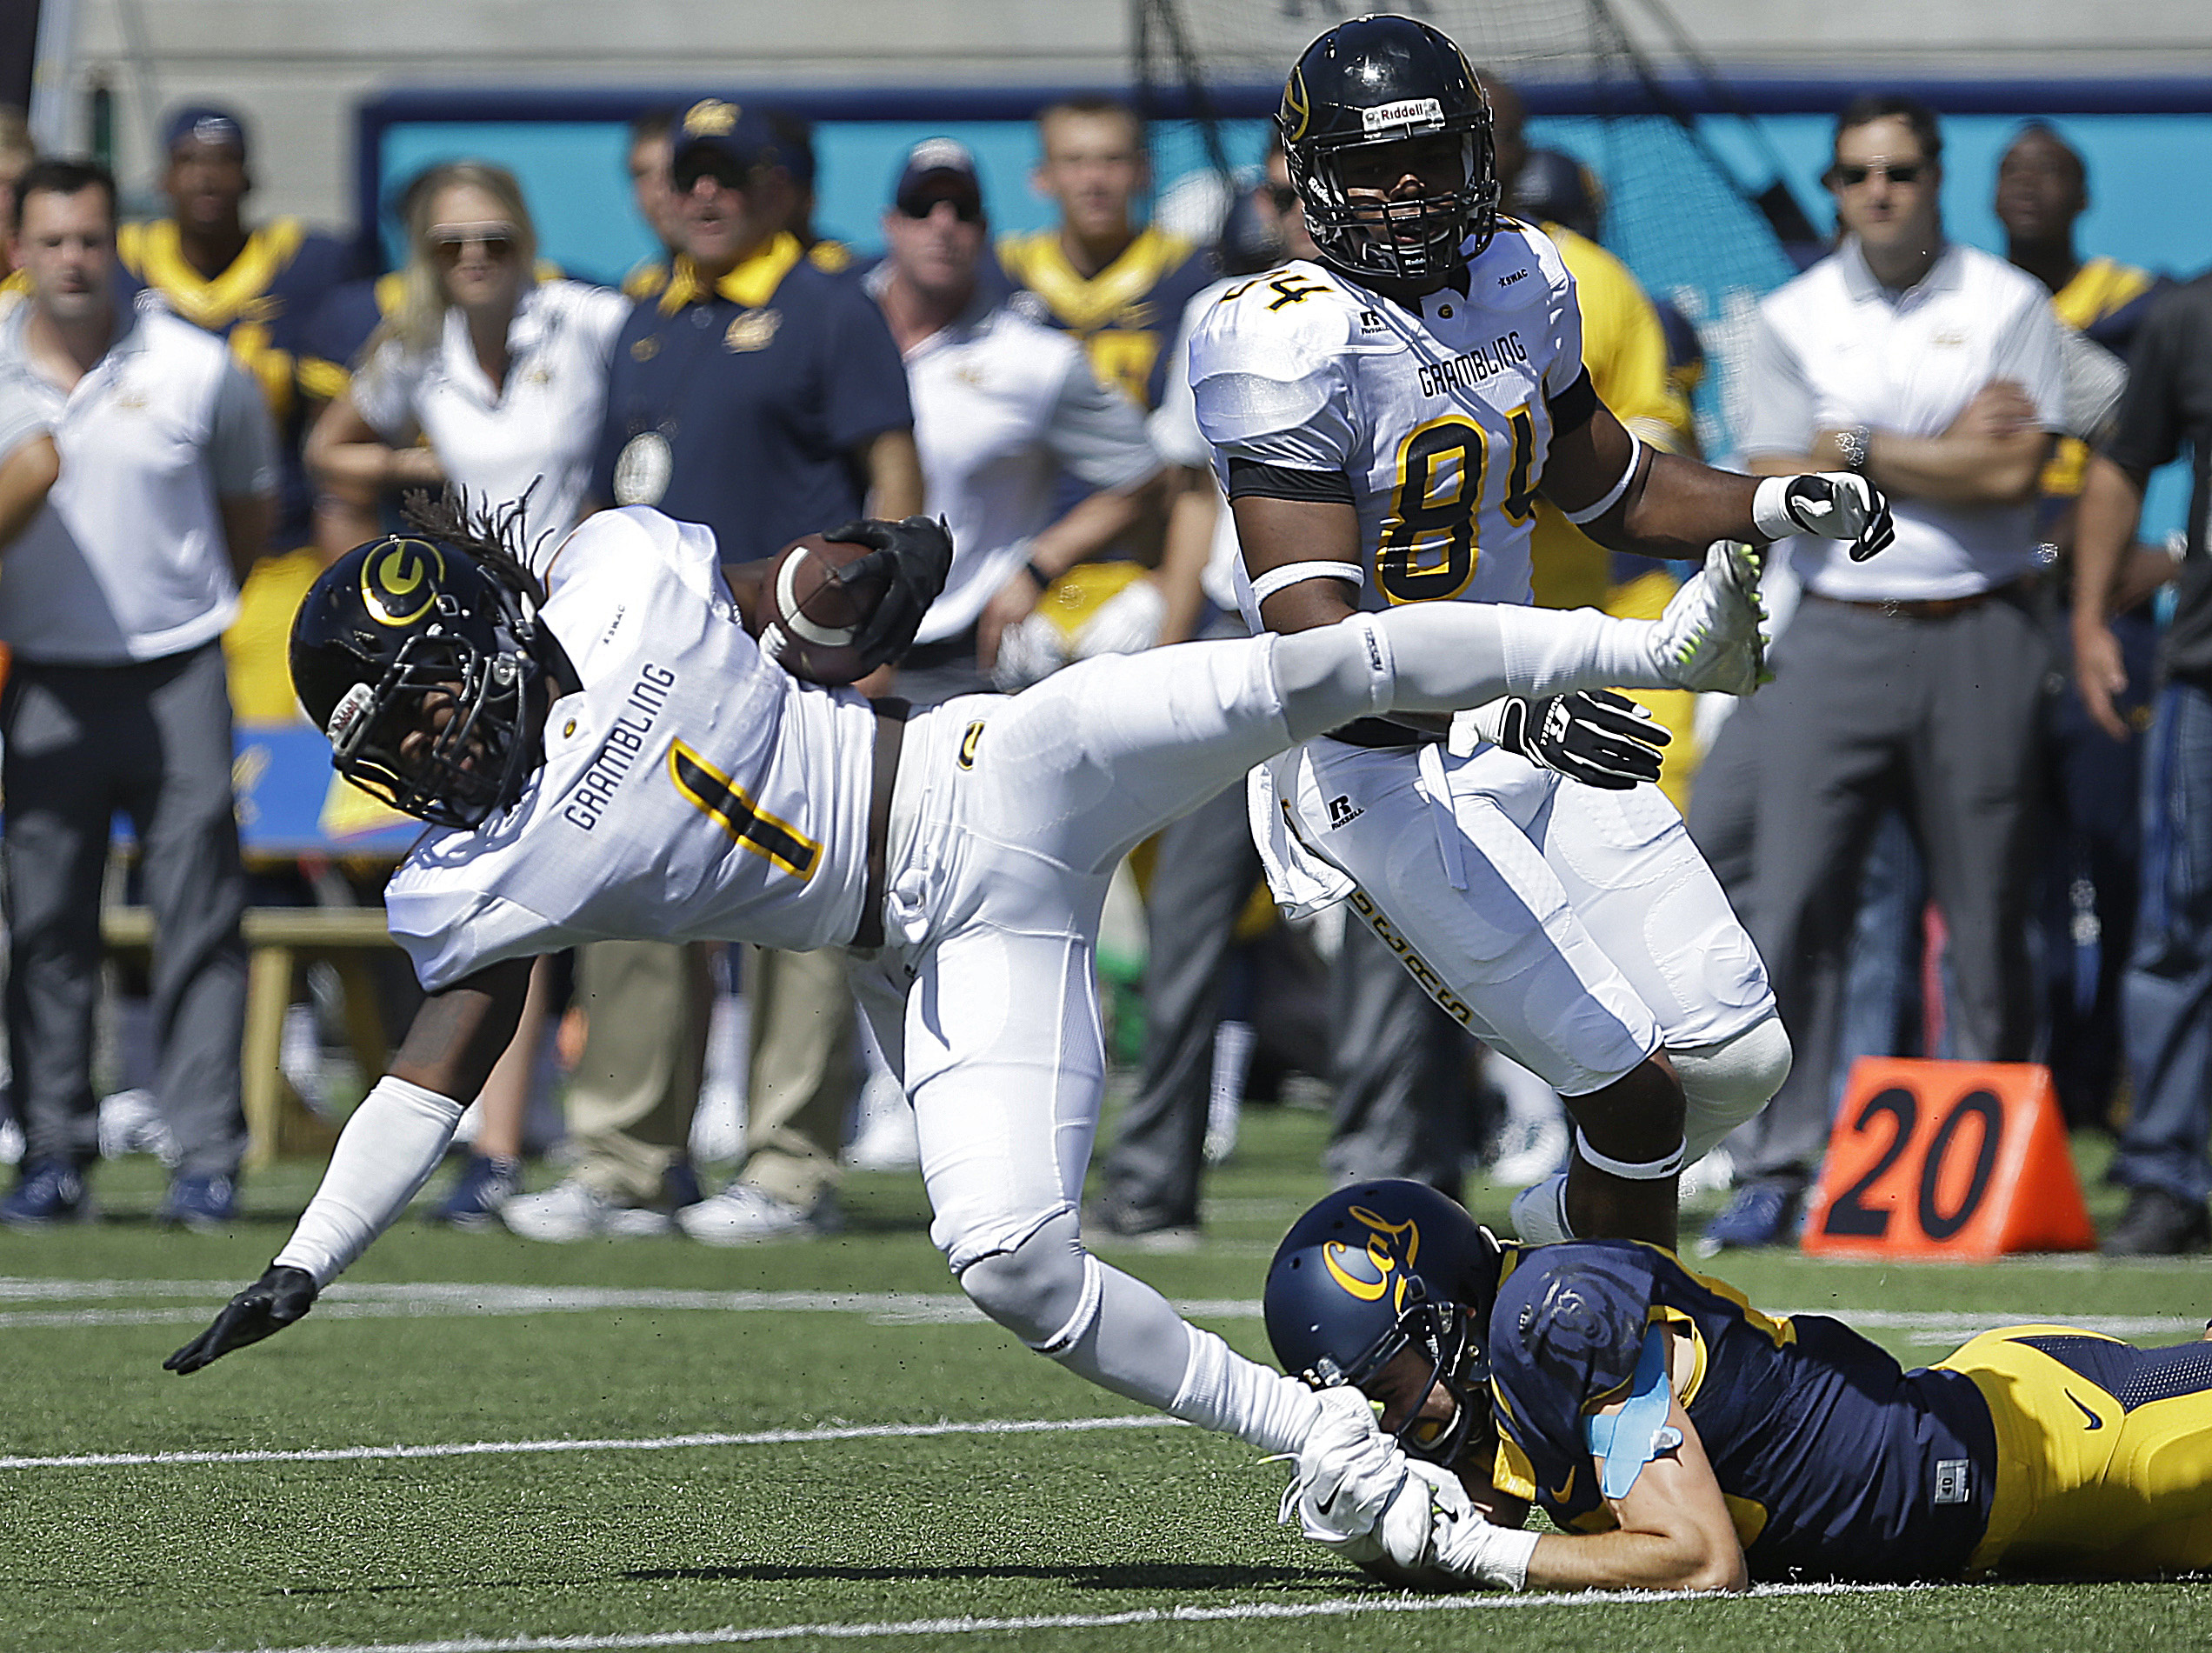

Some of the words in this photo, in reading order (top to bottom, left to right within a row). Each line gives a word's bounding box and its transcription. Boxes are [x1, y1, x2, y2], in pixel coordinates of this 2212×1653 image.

[1381, 103, 1423, 122] Riddell
[1418, 330, 1528, 397] GRAMBLING
[564, 663, 676, 831] GRAMBLING
[666, 736, 824, 883] 1
[1331, 808, 1365, 830] RUSSELL
[1822, 1087, 2003, 1242] 20
[1322, 1205, 1420, 1318] Cal
